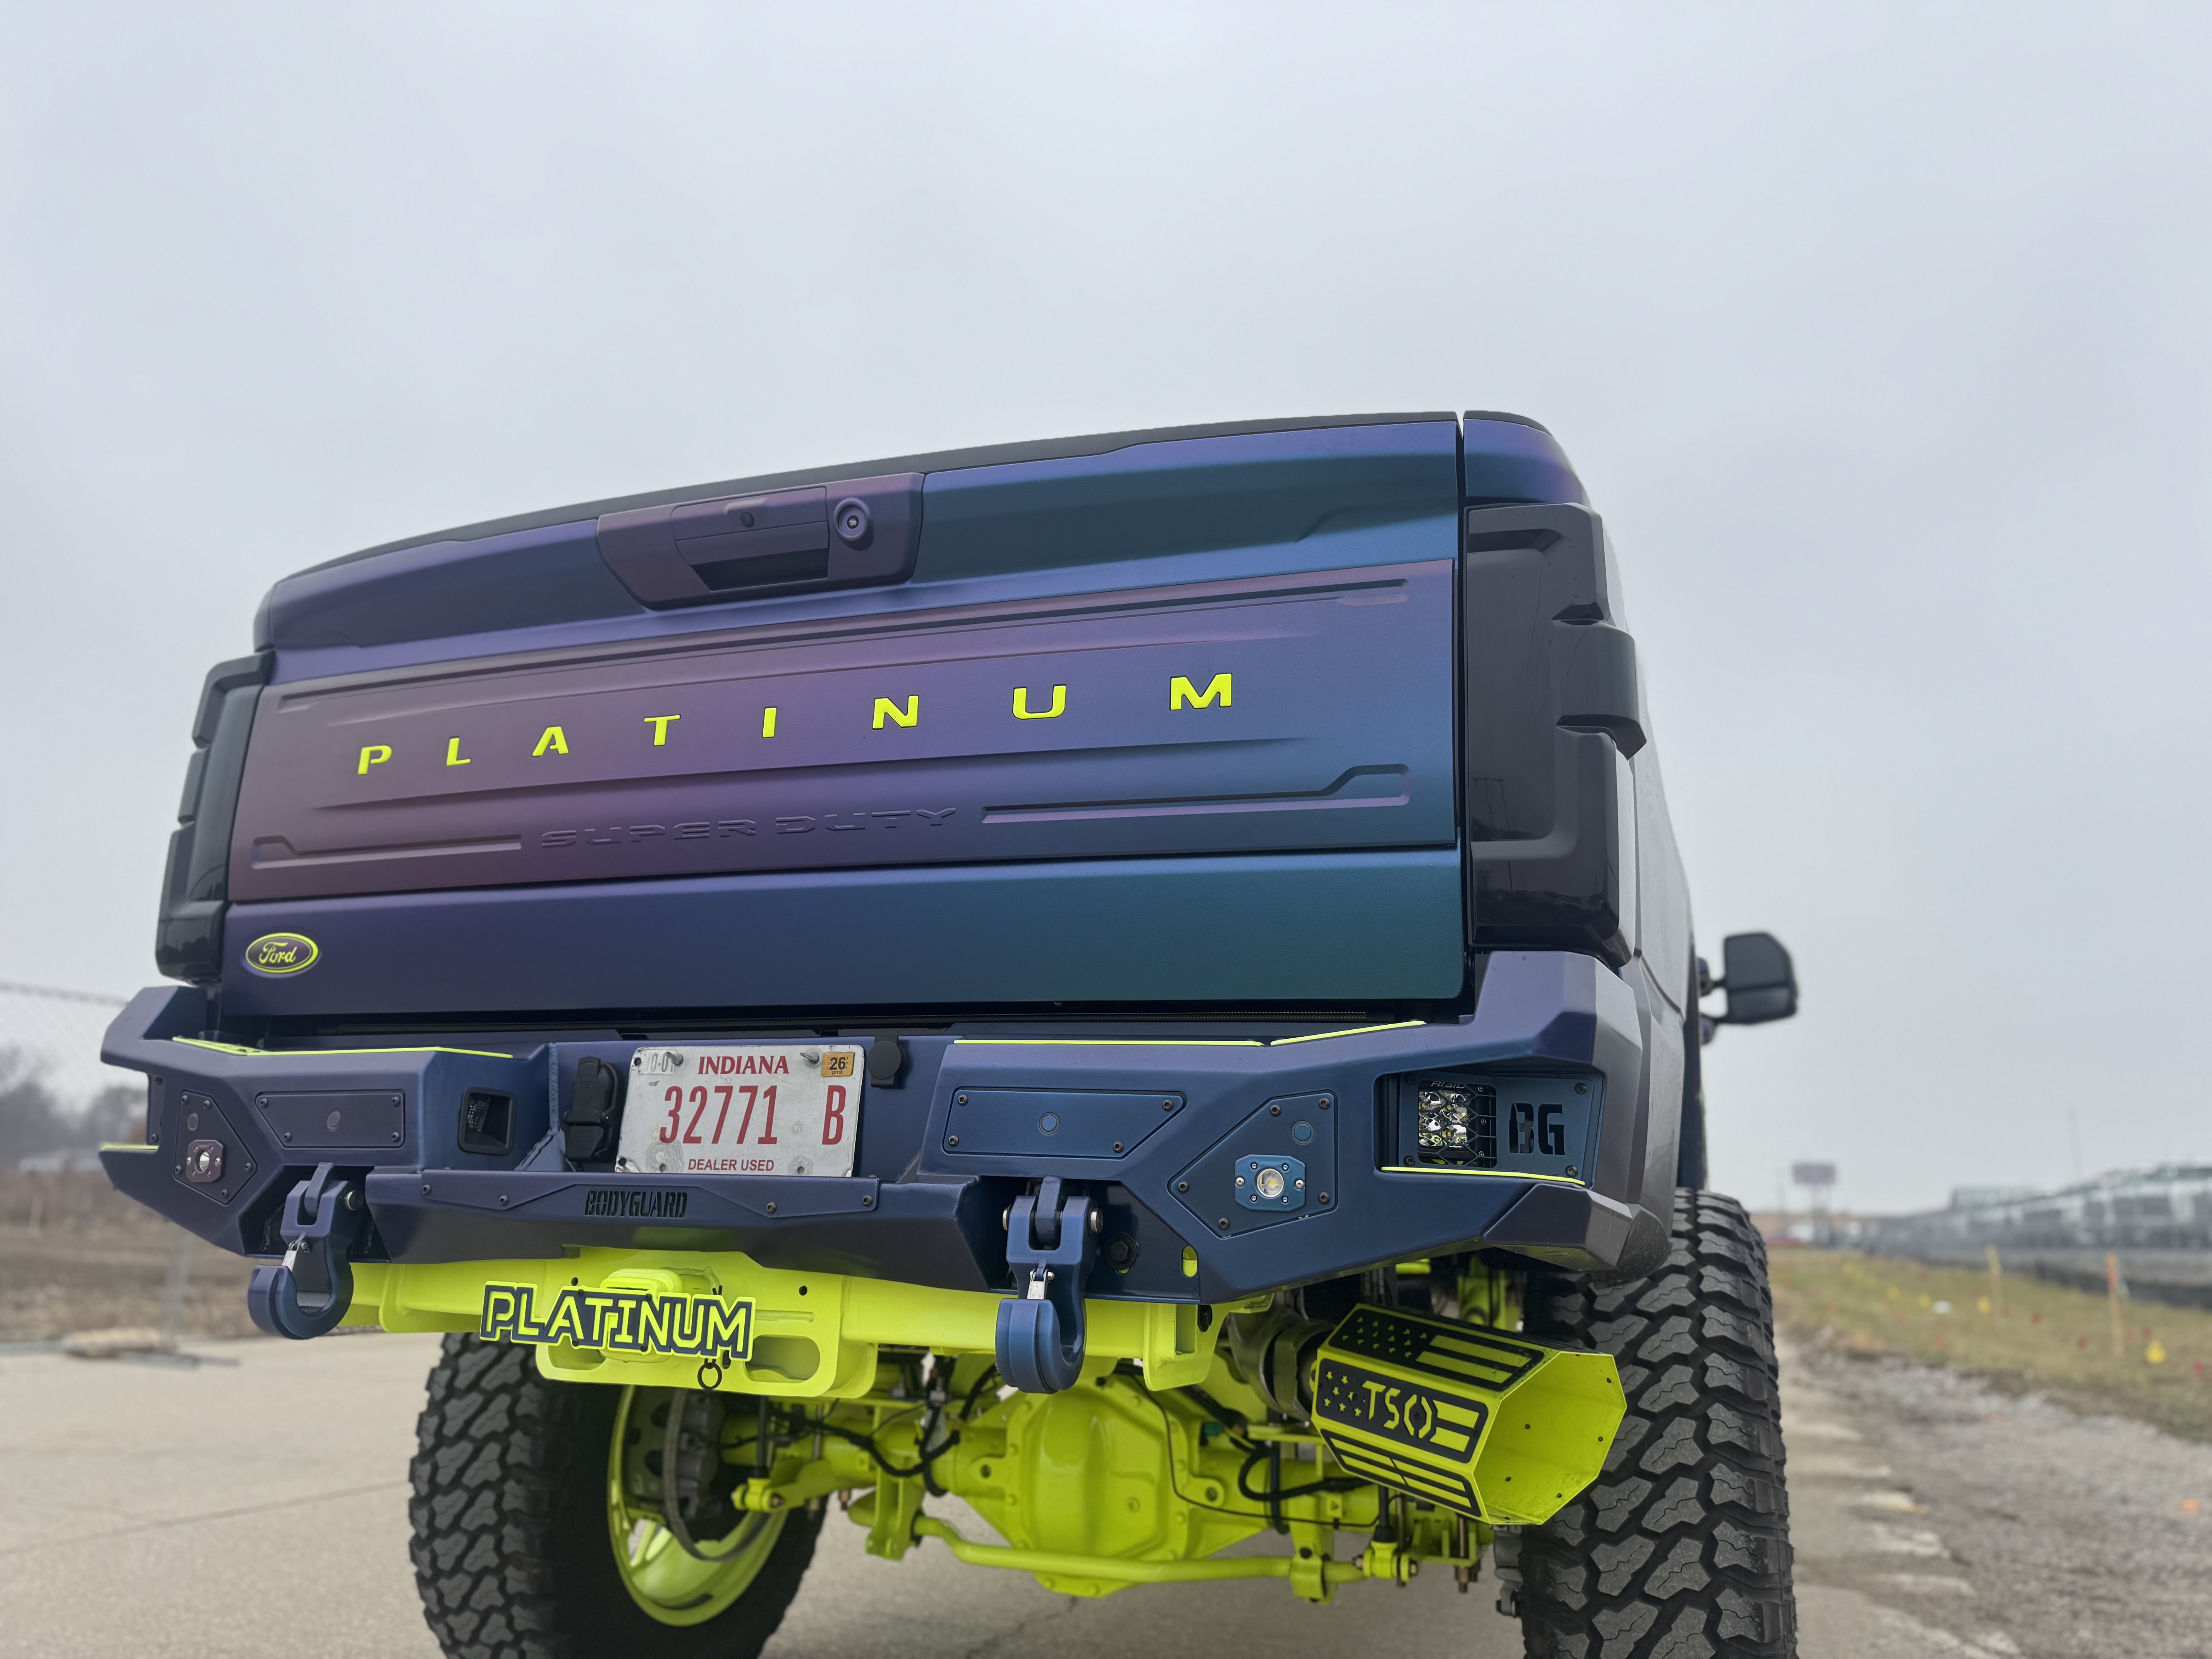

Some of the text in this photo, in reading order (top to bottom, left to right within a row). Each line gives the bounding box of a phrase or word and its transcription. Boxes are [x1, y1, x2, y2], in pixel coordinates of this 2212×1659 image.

[357, 673, 1233, 775] PLATINUM
[541, 807, 957, 848] SUPER DUTY
[259, 941, 297, 964] Ford
[698, 1055, 790, 1075] INDIANA
[829, 1057, 846, 1070] 26
[659, 1085, 847, 1145] 32771 B
[1509, 1103, 1565, 1156] BG
[688, 1159, 775, 1171] DEALER USED
[584, 1190, 688, 1219] BODYGUARD
[481, 1283, 754, 1360] PLATINUM
[1362, 1380, 1432, 1439] TSO
